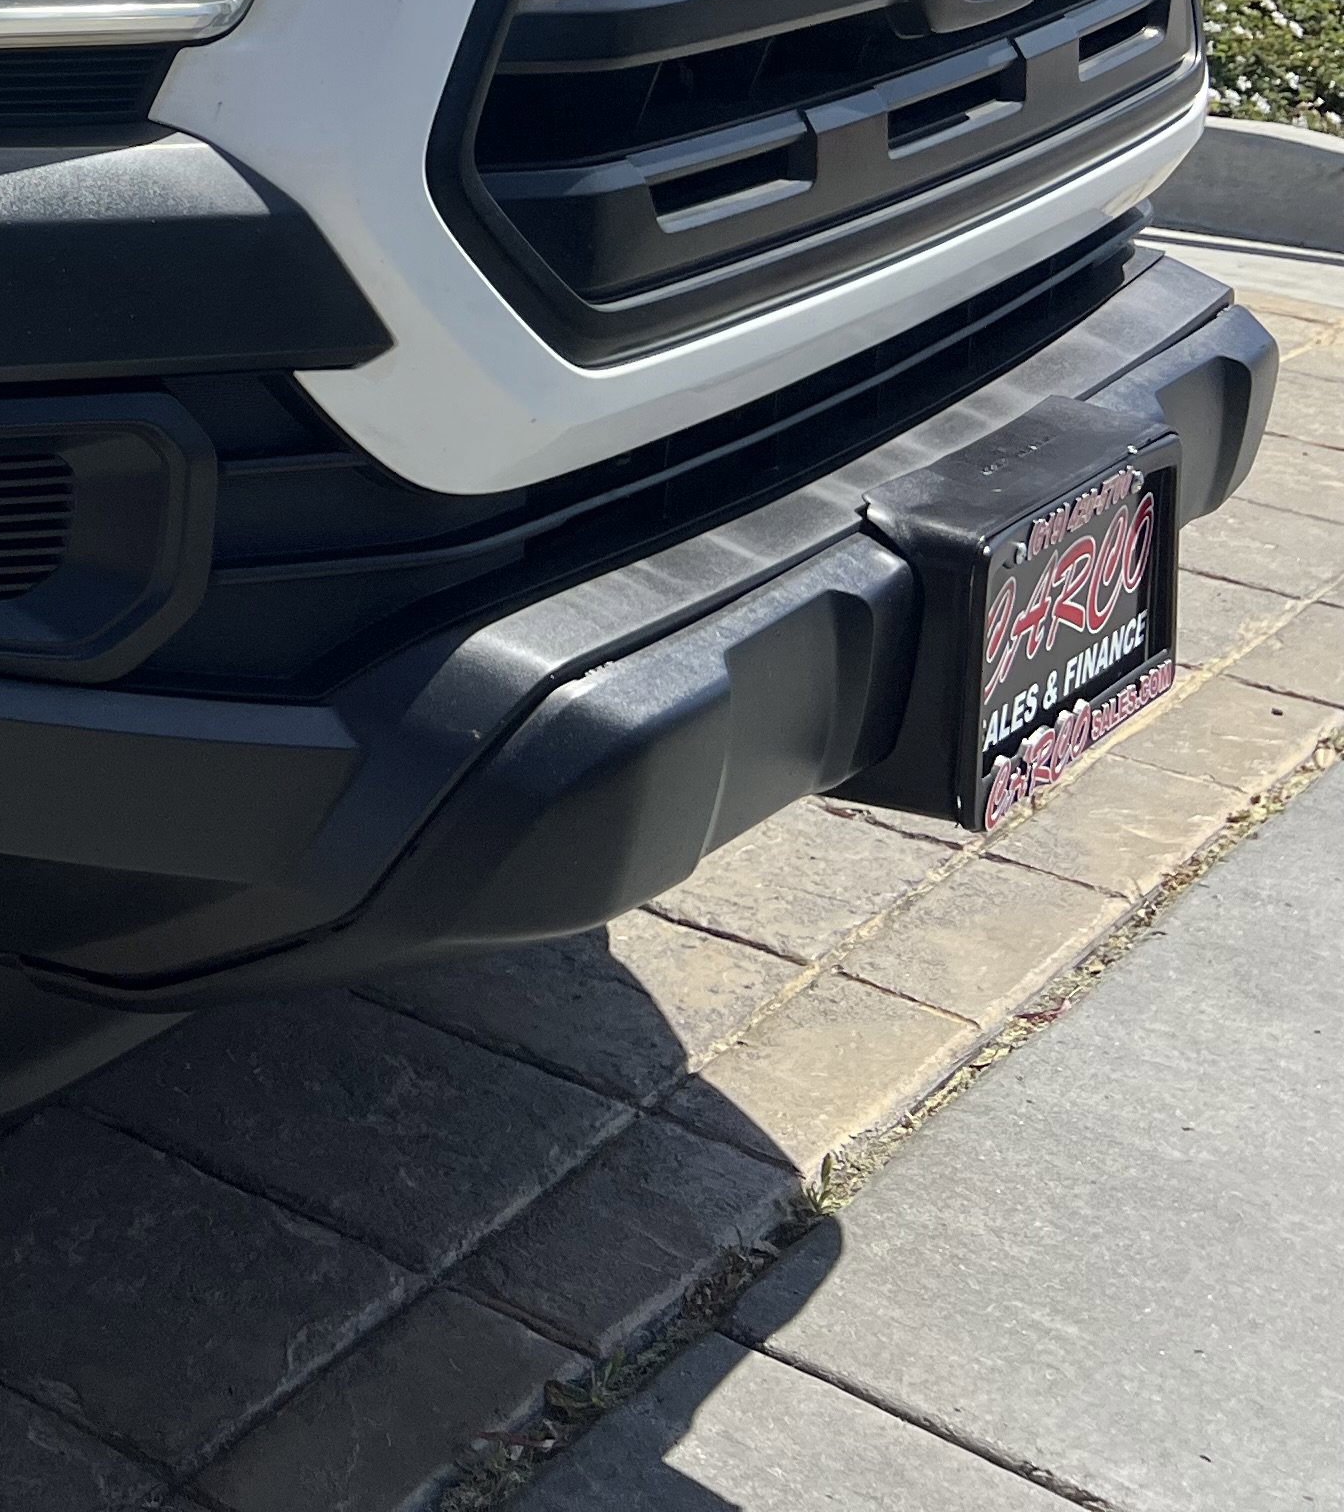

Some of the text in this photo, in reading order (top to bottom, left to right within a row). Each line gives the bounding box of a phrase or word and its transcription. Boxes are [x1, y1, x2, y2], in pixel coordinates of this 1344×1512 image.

[982, 609, 1149, 753] ALES & FINANCE
